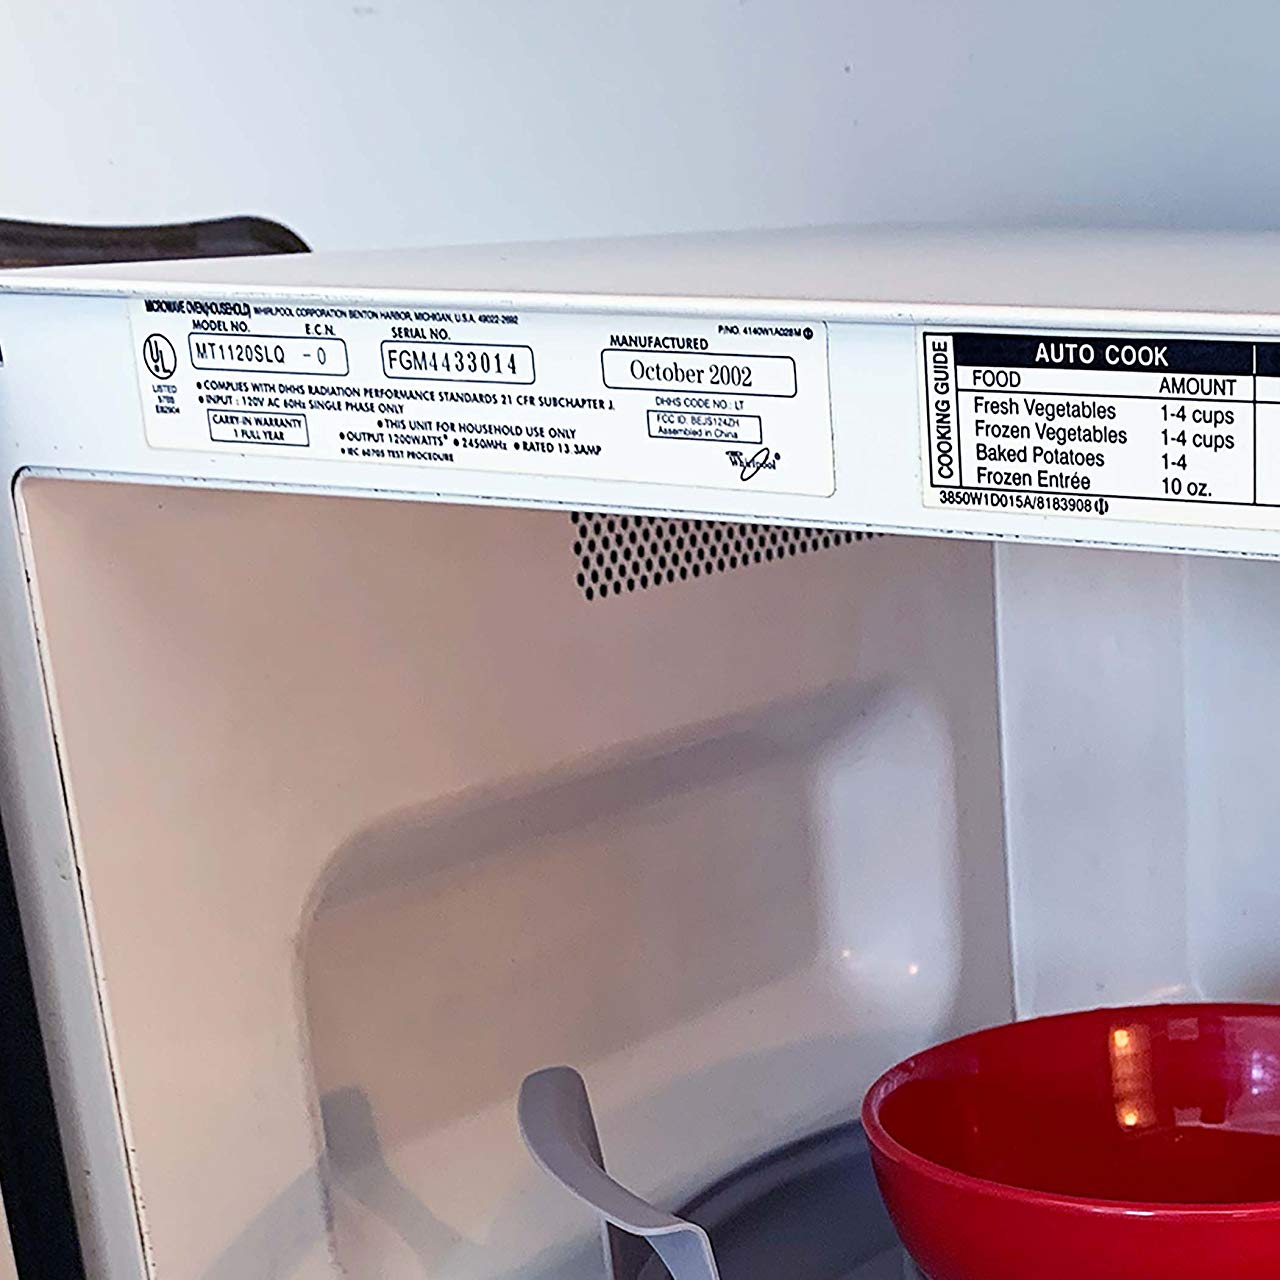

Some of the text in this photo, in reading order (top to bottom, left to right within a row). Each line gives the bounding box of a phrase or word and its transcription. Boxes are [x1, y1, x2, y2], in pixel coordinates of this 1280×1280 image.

[296, 307, 347, 319] CORPORATION
[349, 308, 379, 319] BENTON
[192, 319, 251, 333] MODEL NO.
[392, 327, 451, 340] SERIAL NO.
[196, 342, 286, 364] MT1120SLQ
[610, 335, 709, 351] MANUFACTURED
[388, 351, 518, 376] FGM4433014
[1035, 342, 1169, 367] AUTO COOK
[630, 358, 753, 387] October 2002
[972, 369, 1021, 388] FOOD
[152, 384, 177, 394] LISTED
[204, 380, 249, 394] COMPLIES
[251, 382, 276, 394] WITH
[279, 383, 305, 395] DHHS
[308, 385, 360, 398] RADIATION
[363, 386, 436, 402] PERFORMANCE
[438, 390, 499, 405] STANDARDS
[501, 393, 513, 406] 21
[516, 394, 536, 407] CFR
[538, 396, 606, 411] SUBCHAPTER
[1159, 377, 1237, 397] AMOUNT
[206, 394, 232, 406] INPUT
[242, 396, 264, 407] 120V
[267, 397, 281, 408] AC
[309, 399, 342, 412] SINGLE
[345, 401, 375, 412] PHASE
[378, 403, 404, 414] ONLY
[655, 397, 681, 406] DHHS
[683, 398, 709, 409] CODE
[735, 401, 744, 410] LT
[931, 340, 954, 480] COOKING GUIDE
[973, 396, 1116, 423] Fresh Vegetables
[254, 416, 303, 429] WARRANTY
[656, 414, 675, 424] FCC
[1160, 404, 1235, 428] 1-4 cups
[240, 429, 262, 441] FULL
[263, 431, 286, 442] YEAR
[346, 432, 385, 443] OUTPUT
[385, 418, 577, 440] THIS UNIT FOR HOUSEHOLD USE ONLY
[658, 426, 738, 439] Assembled in China
[974, 420, 1128, 447] Frozen Vegetables
[522, 441, 554, 453] RATED
[1160, 429, 1236, 453] 1-4 cups
[388, 450, 404, 459] TEST
[407, 451, 454, 463] PROCEDURE
[976, 443, 1105, 468] Baked Potatoes
[1161, 453, 1188, 471] 1-4
[976, 467, 1091, 491] Frozen Entrée
[1162, 477, 1212, 498] 10 oz.
